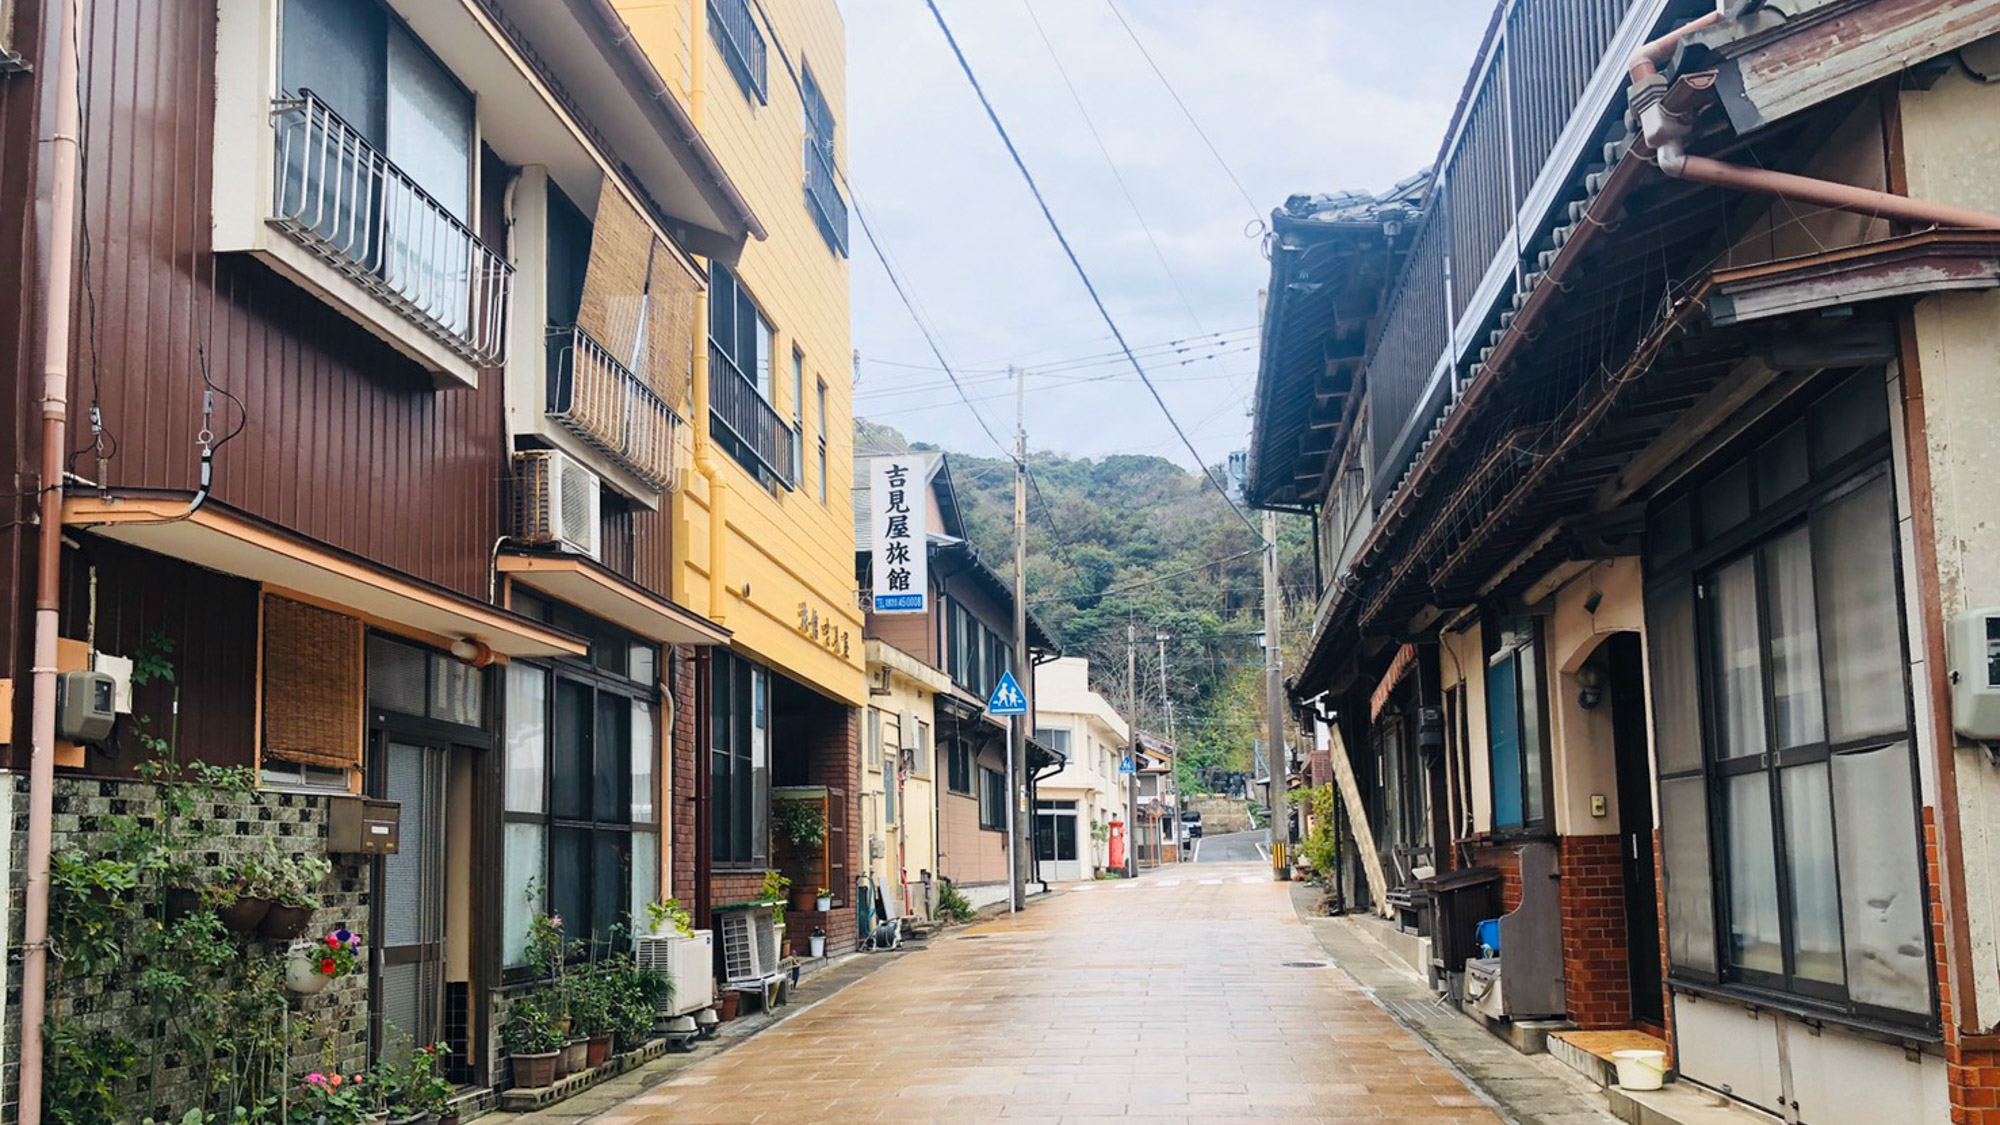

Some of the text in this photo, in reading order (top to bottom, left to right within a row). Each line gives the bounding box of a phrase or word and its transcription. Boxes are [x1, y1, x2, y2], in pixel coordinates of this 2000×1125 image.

[884, 464, 911, 592] 吉見屋旅館
